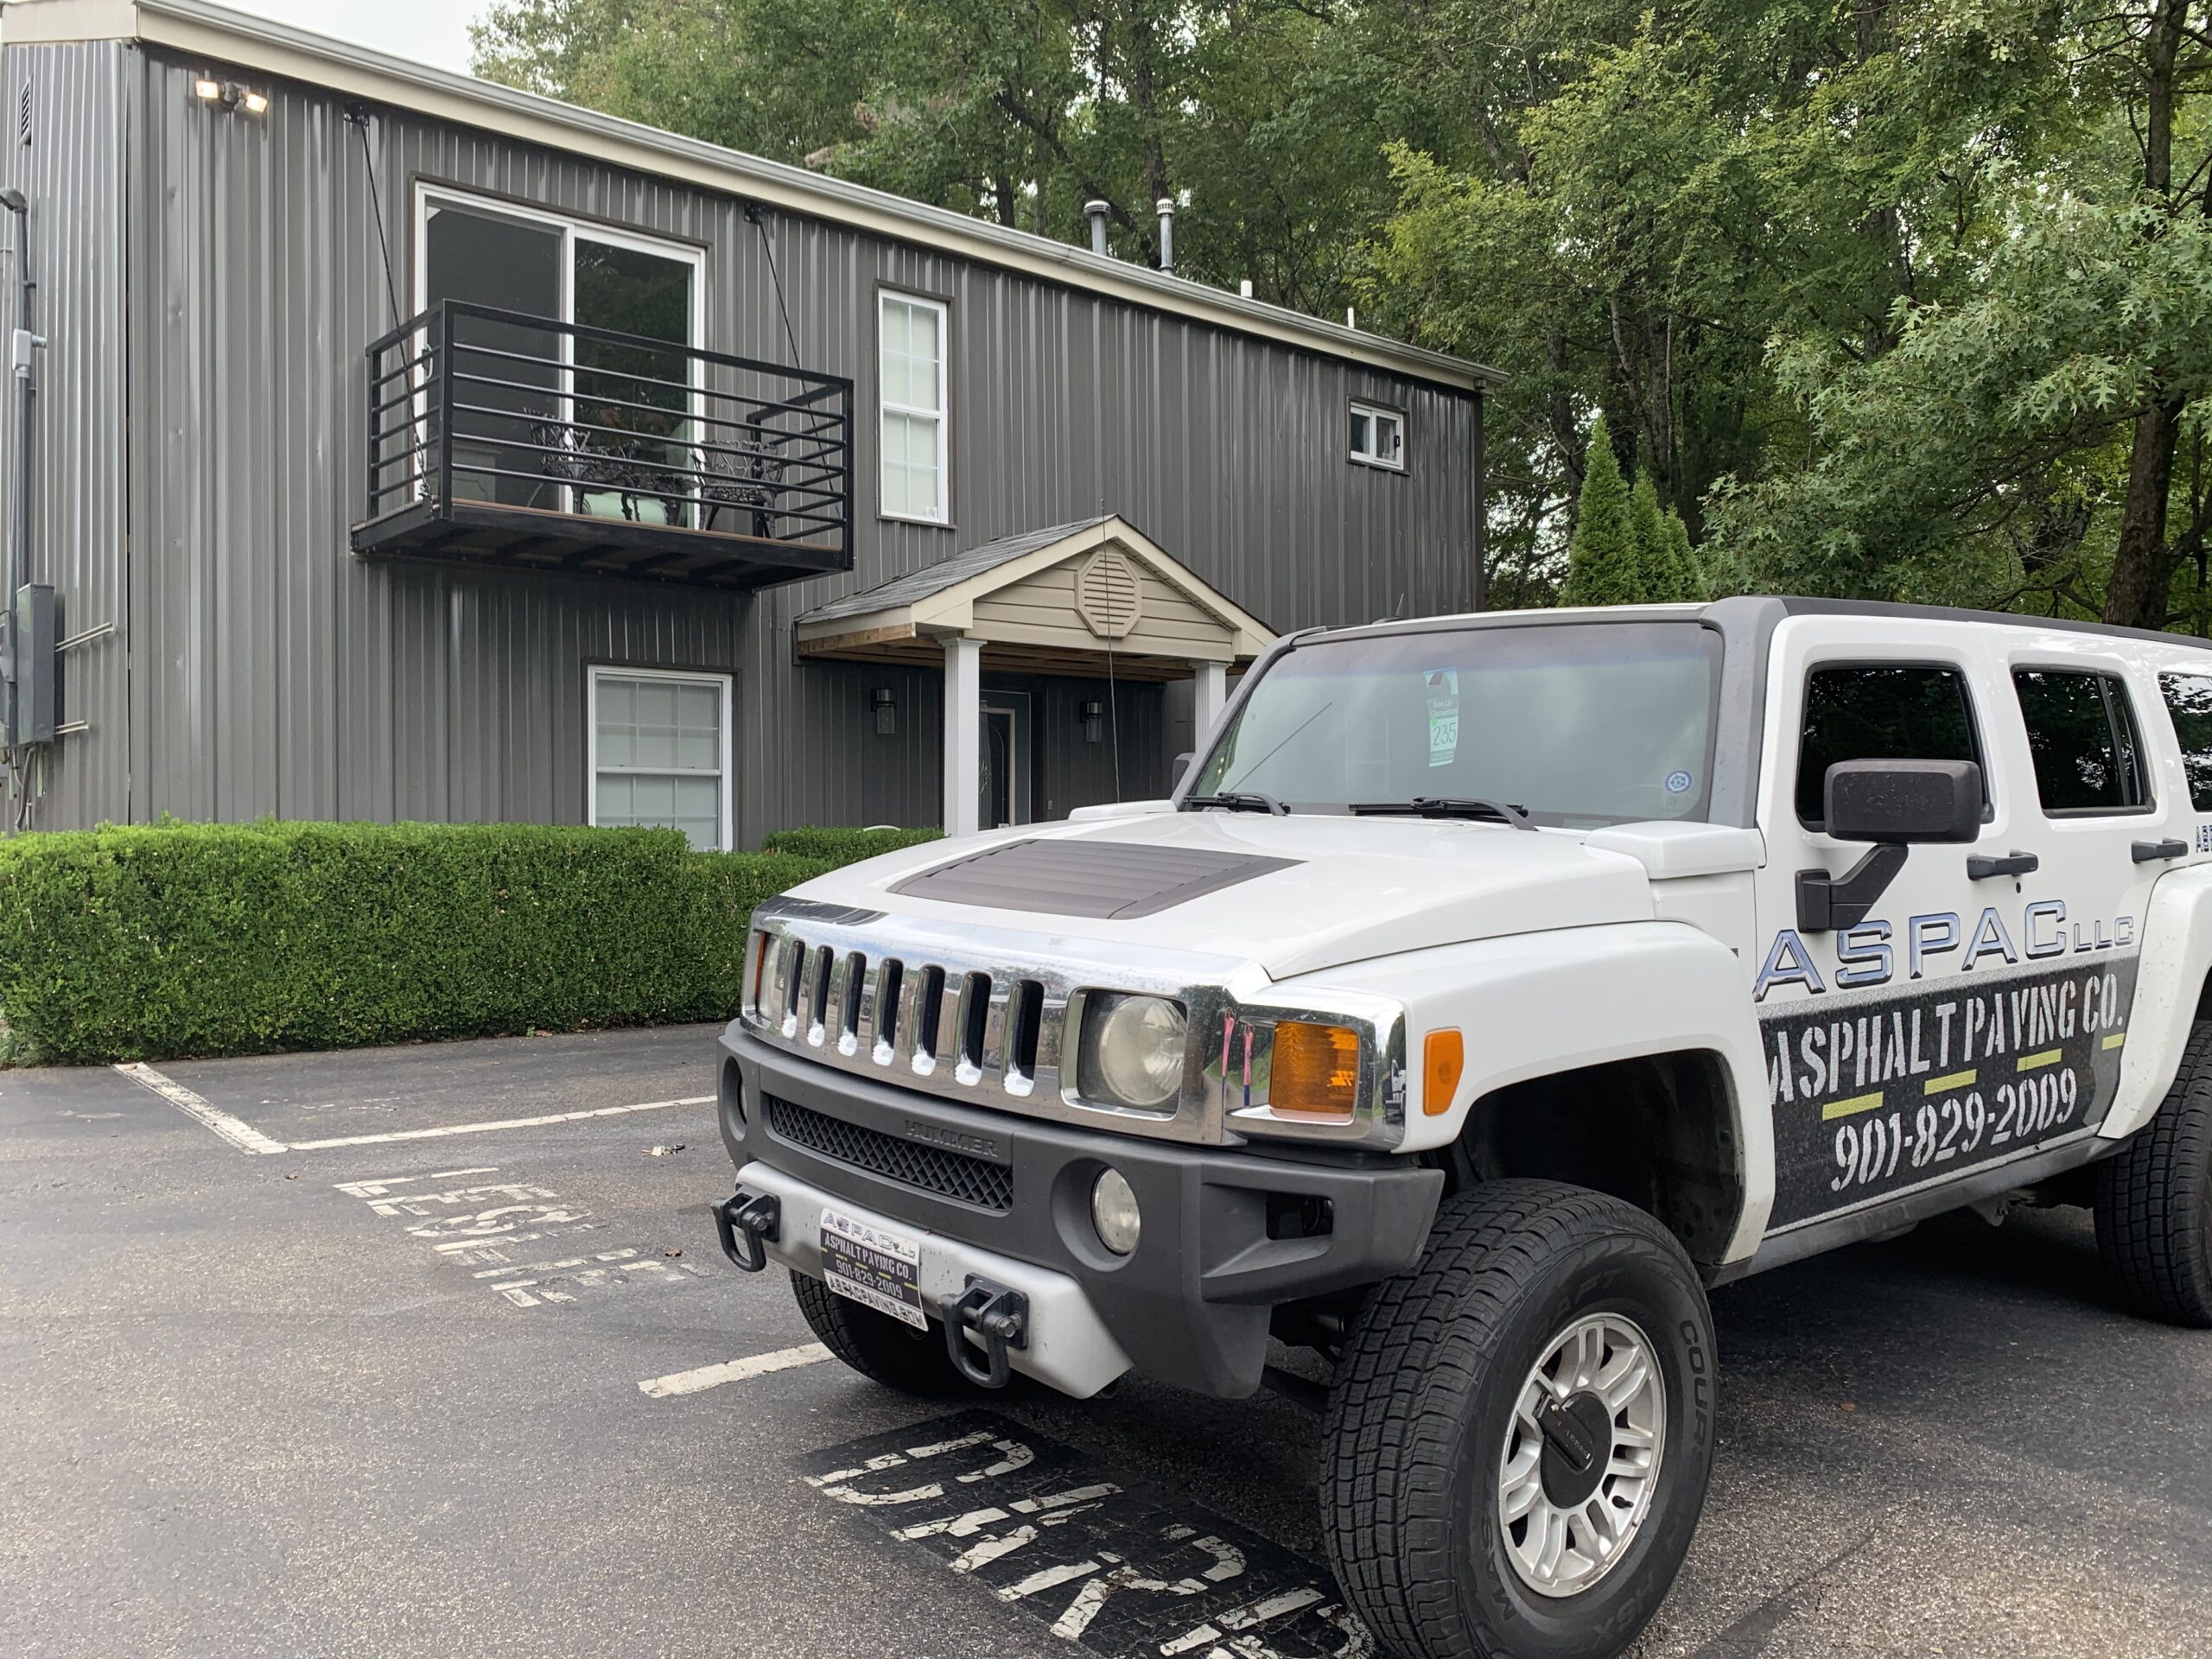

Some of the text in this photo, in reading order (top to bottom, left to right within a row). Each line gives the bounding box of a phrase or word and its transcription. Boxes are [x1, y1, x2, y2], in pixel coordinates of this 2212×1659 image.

[1433, 721, 1457, 747] 235
[1753, 899, 2135, 1003] ASPAC LLC
[1770, 972, 2124, 1106] ASPHALT PAVING CO.
[905, 1120, 999, 1158] HUMMER
[1829, 1067, 2078, 1192] 901-829-2009
[333, 1167, 698, 1307] LESLIE
[823, 1212, 893, 1251] ASPAC
[824, 1233, 912, 1281] ASPHALT PAVING CO.
[836, 1259, 904, 1300] 901-829-2009
